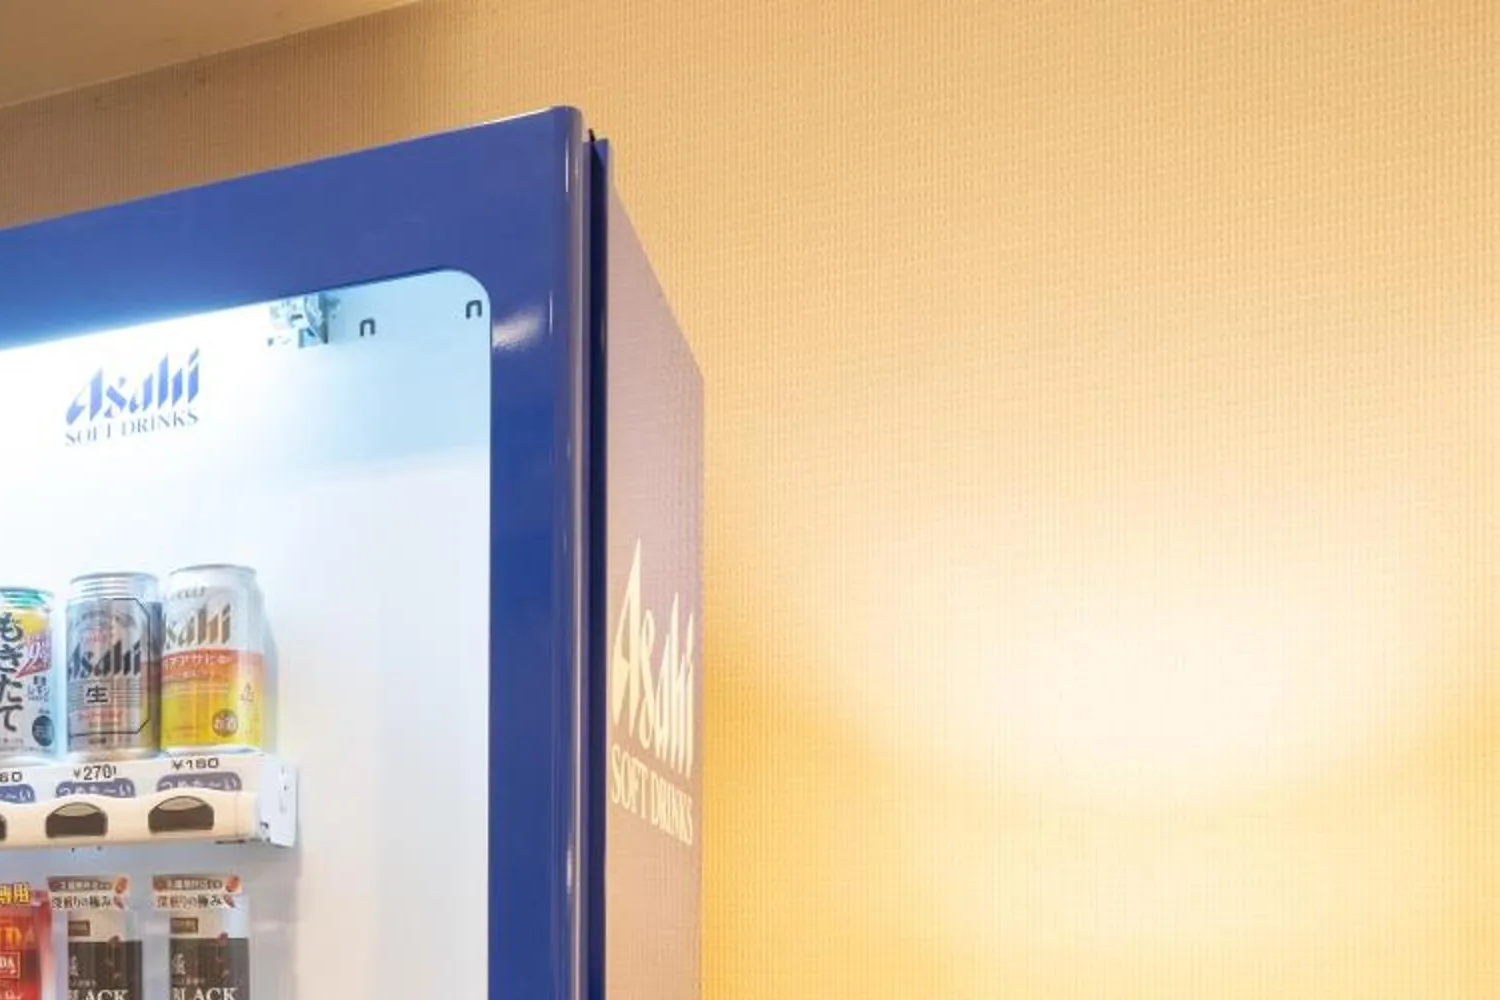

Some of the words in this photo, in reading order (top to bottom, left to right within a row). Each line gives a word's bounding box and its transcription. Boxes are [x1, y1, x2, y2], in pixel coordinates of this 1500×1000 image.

[66, 348, 199, 425] Asahi
[65, 423, 113, 447] SOFT
[121, 410, 200, 436] DRINKS
[85, 685, 110, 705] 生
[612, 537, 695, 779] Asahi
[612, 744, 649, 821] SOFT
[651, 769, 694, 846] DRINKS
